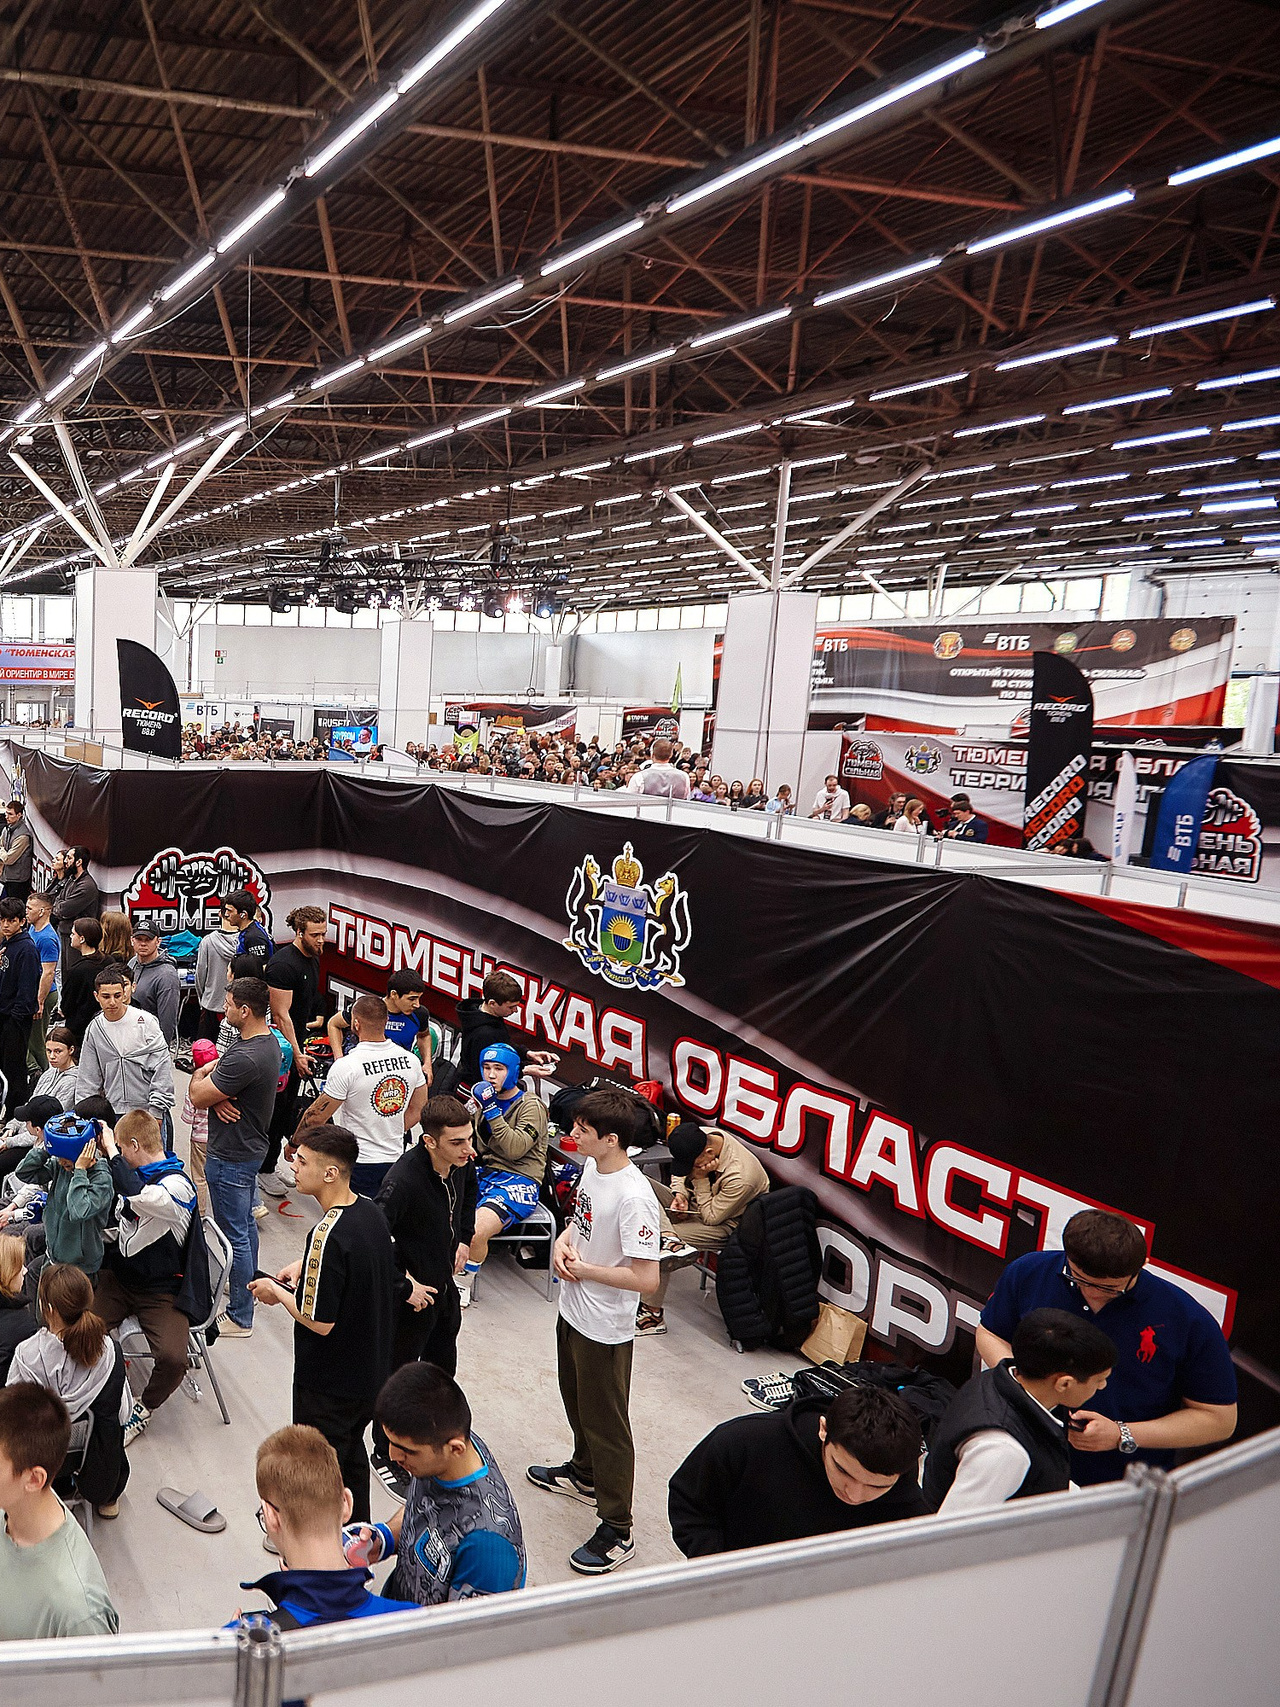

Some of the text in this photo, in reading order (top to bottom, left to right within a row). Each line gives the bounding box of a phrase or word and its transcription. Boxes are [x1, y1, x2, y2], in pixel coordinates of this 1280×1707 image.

[824, 638, 848, 653] ВТБ
[996, 635, 1030, 651] ВТБ
[7, 668, 43, 679] ОРИЕНТИР
[43, 669, 49, 679] В
[49, 669, 69, 679] МИРЕ
[950, 667, 1034, 678] ОТКРЫТЫЙ ТУРНИ
[992, 679, 1007, 688] ПО
[196, 705, 218, 716] ВТБ
[1033, 702, 1087, 712] RECORD
[122, 708, 175, 723] RECORD
[136, 719, 162, 729] ТЮМЕНЬ
[846, 757, 882, 769] ТЮМЕНЬ
[845, 767, 882, 778] СИЛЬНАЯ
[1024, 754, 1087, 823] RECORD
[1026, 796, 1083, 850] ECORD
[1174, 814, 1194, 847] ВТБ
[1199, 831, 1254, 854] ЕНЬ
[132, 908, 221, 931] ТЮМЕ
[330, 907, 647, 1081] ТЮМЕНКАЯ
[362, 1056, 412, 1076] REFEREE
